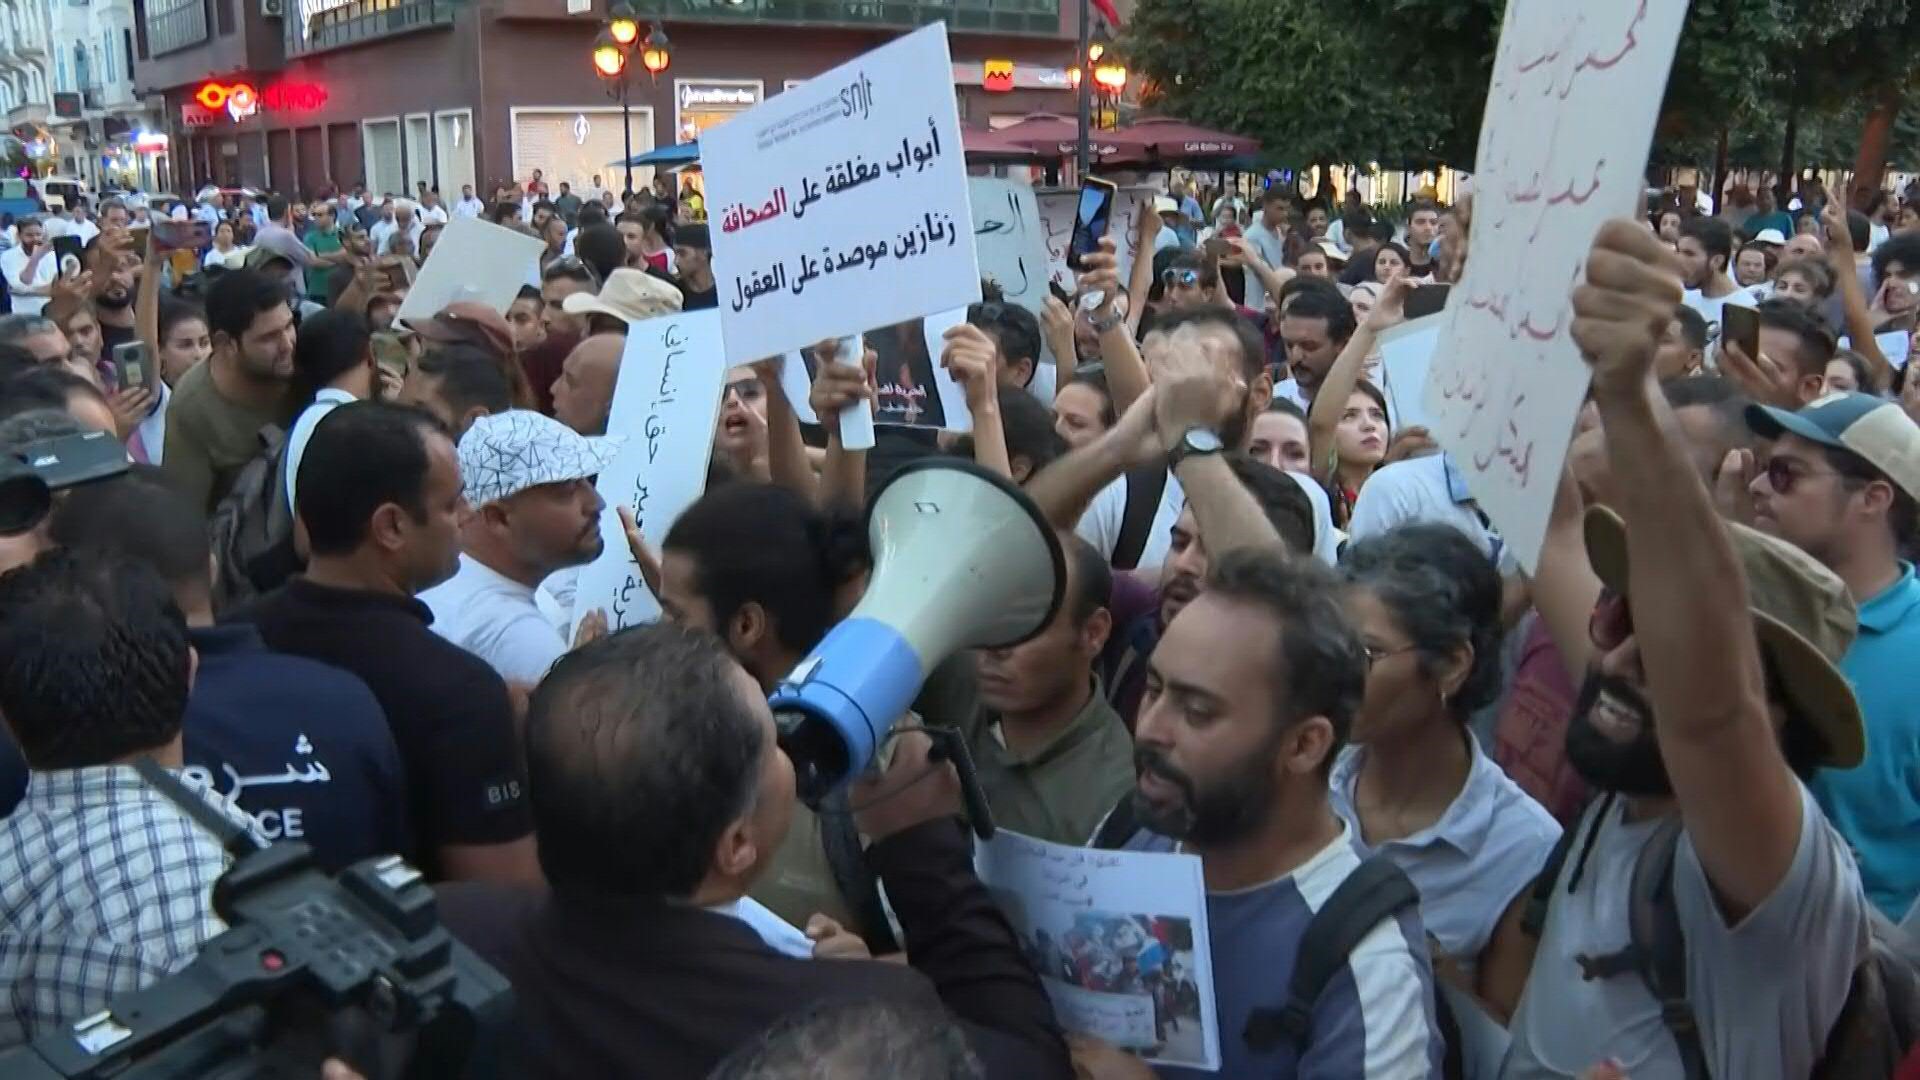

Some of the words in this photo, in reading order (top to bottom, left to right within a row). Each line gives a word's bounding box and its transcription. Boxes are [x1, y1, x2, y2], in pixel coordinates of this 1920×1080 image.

[886, 117, 941, 178] أبواب
[793, 177, 821, 218] على
[826, 155, 880, 194] مغلقة
[722, 187, 787, 233] الصحافة
[824, 240, 888, 270] موصدة
[894, 212, 956, 259] زنازين
[732, 262, 786, 312] العقول
[792, 255, 820, 295] على
[645, 415, 665, 464] حق
